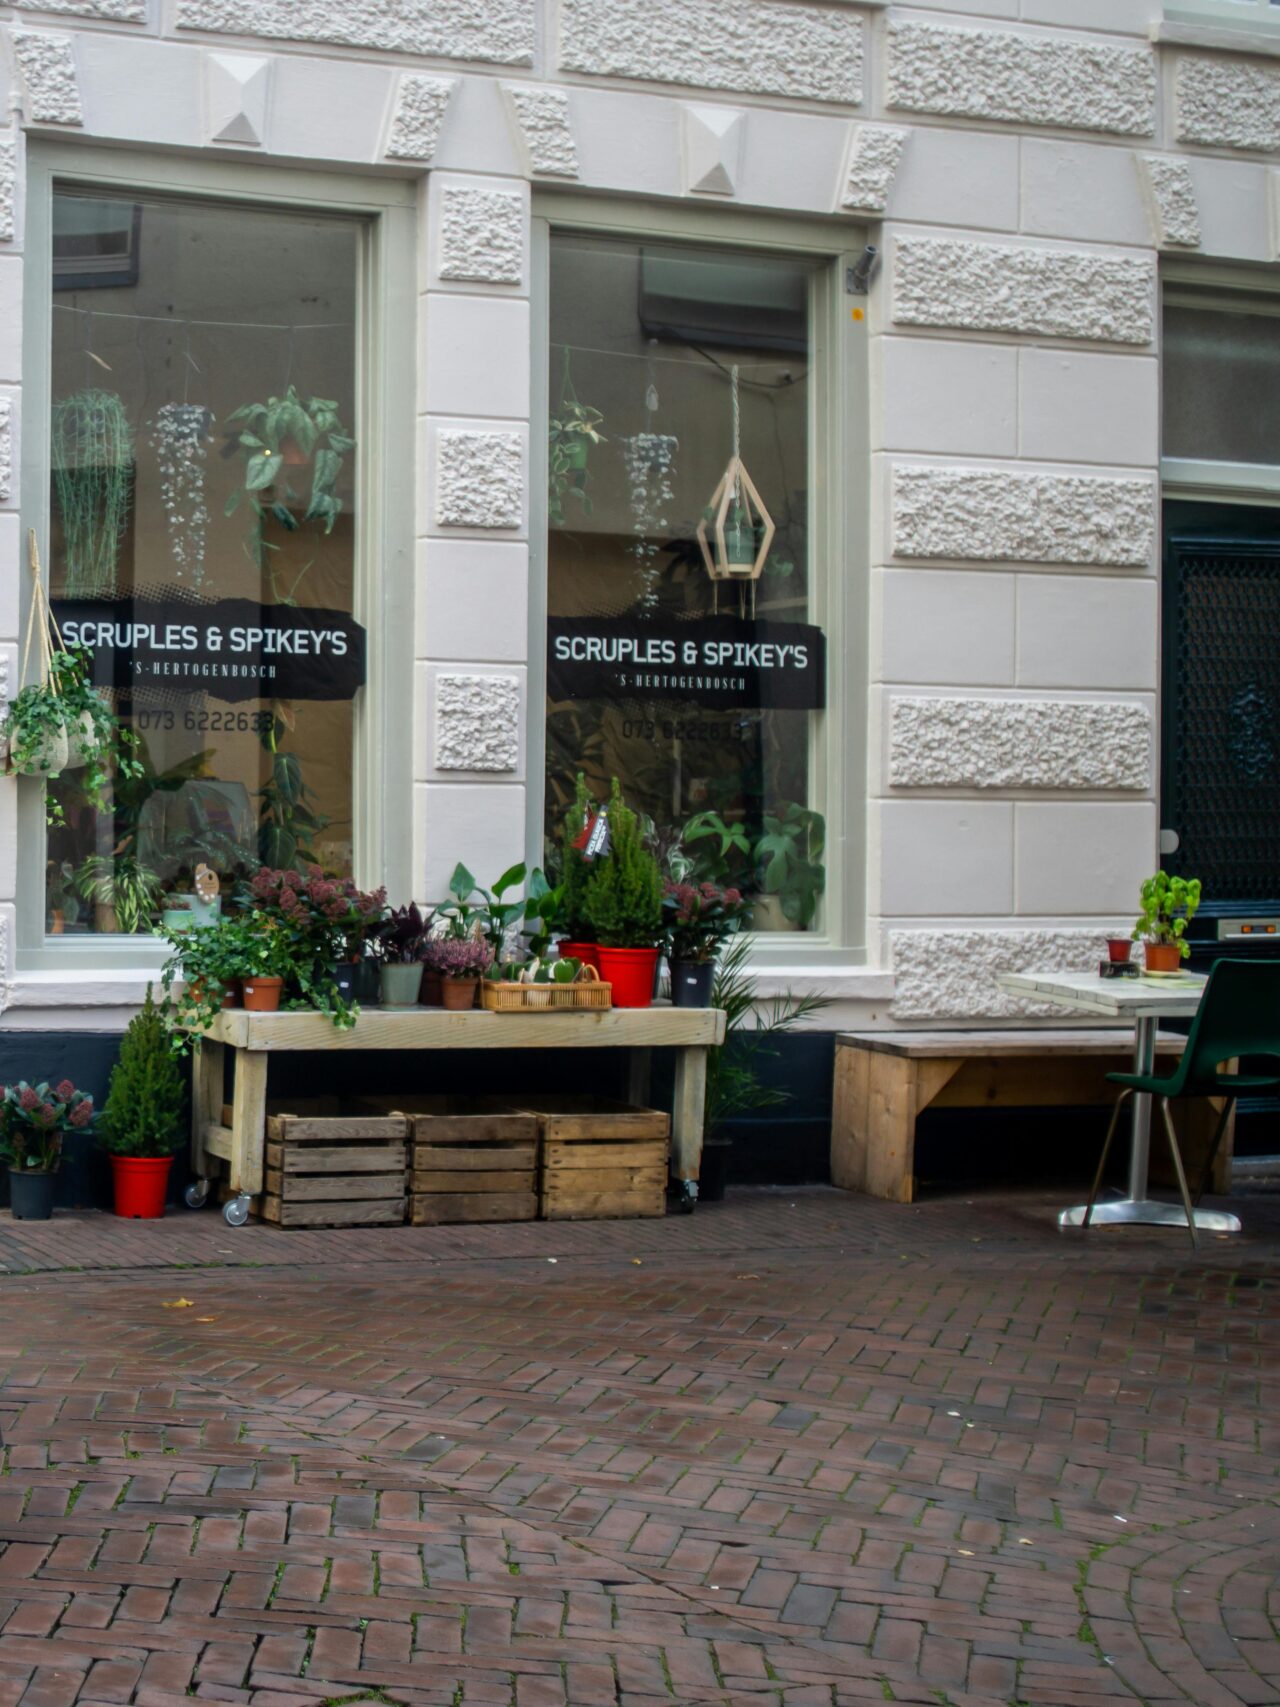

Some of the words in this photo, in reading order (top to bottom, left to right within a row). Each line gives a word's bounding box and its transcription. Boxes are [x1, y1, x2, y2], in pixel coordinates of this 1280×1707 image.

[62, 621, 198, 650] SCRUPLES
[206, 627, 223, 651] &
[229, 627, 348, 655] SPIKEY'S
[555, 636, 675, 664] SCRUPLES
[683, 642, 698, 665] &
[704, 642, 808, 669] SPIKEY'S
[138, 710, 175, 730] 073
[184, 711, 274, 732] 6222633
